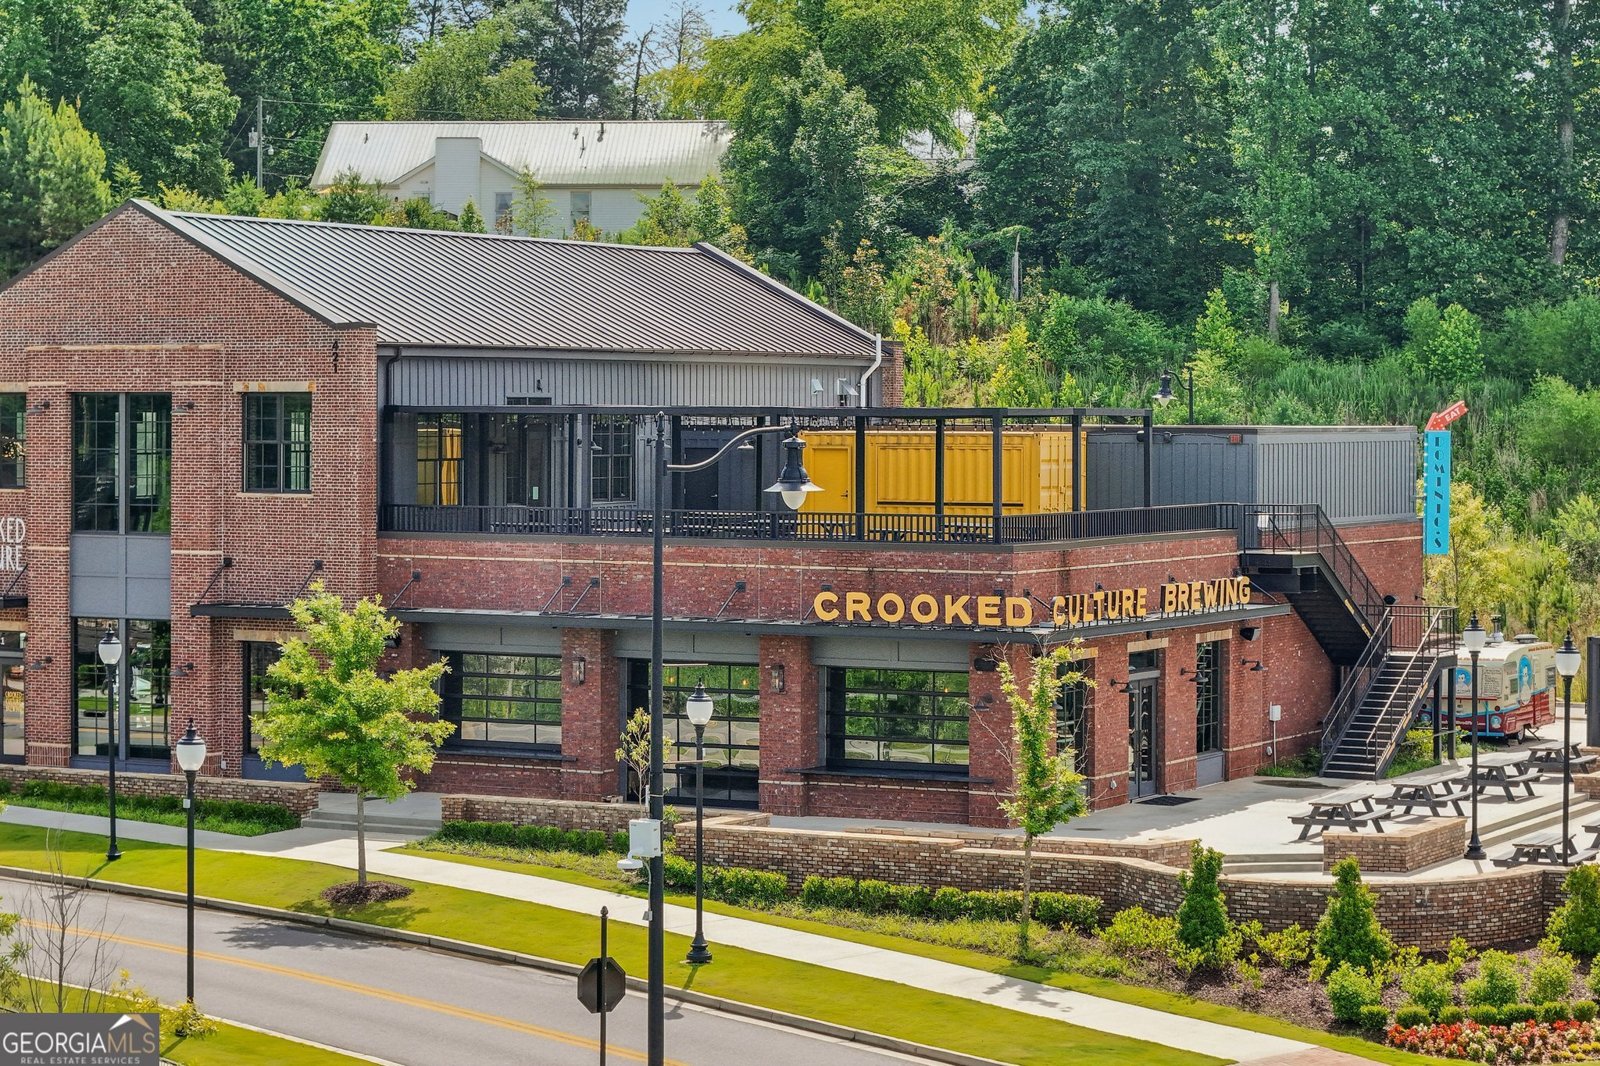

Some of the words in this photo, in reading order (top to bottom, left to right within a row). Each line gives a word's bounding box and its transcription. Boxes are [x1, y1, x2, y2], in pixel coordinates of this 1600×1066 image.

[1444, 407, 1461, 421] EAT
[813, 591, 1034, 627] CROOKED
[1053, 588, 1148, 626] CULTURE
[1162, 575, 1251, 613] BREWING
